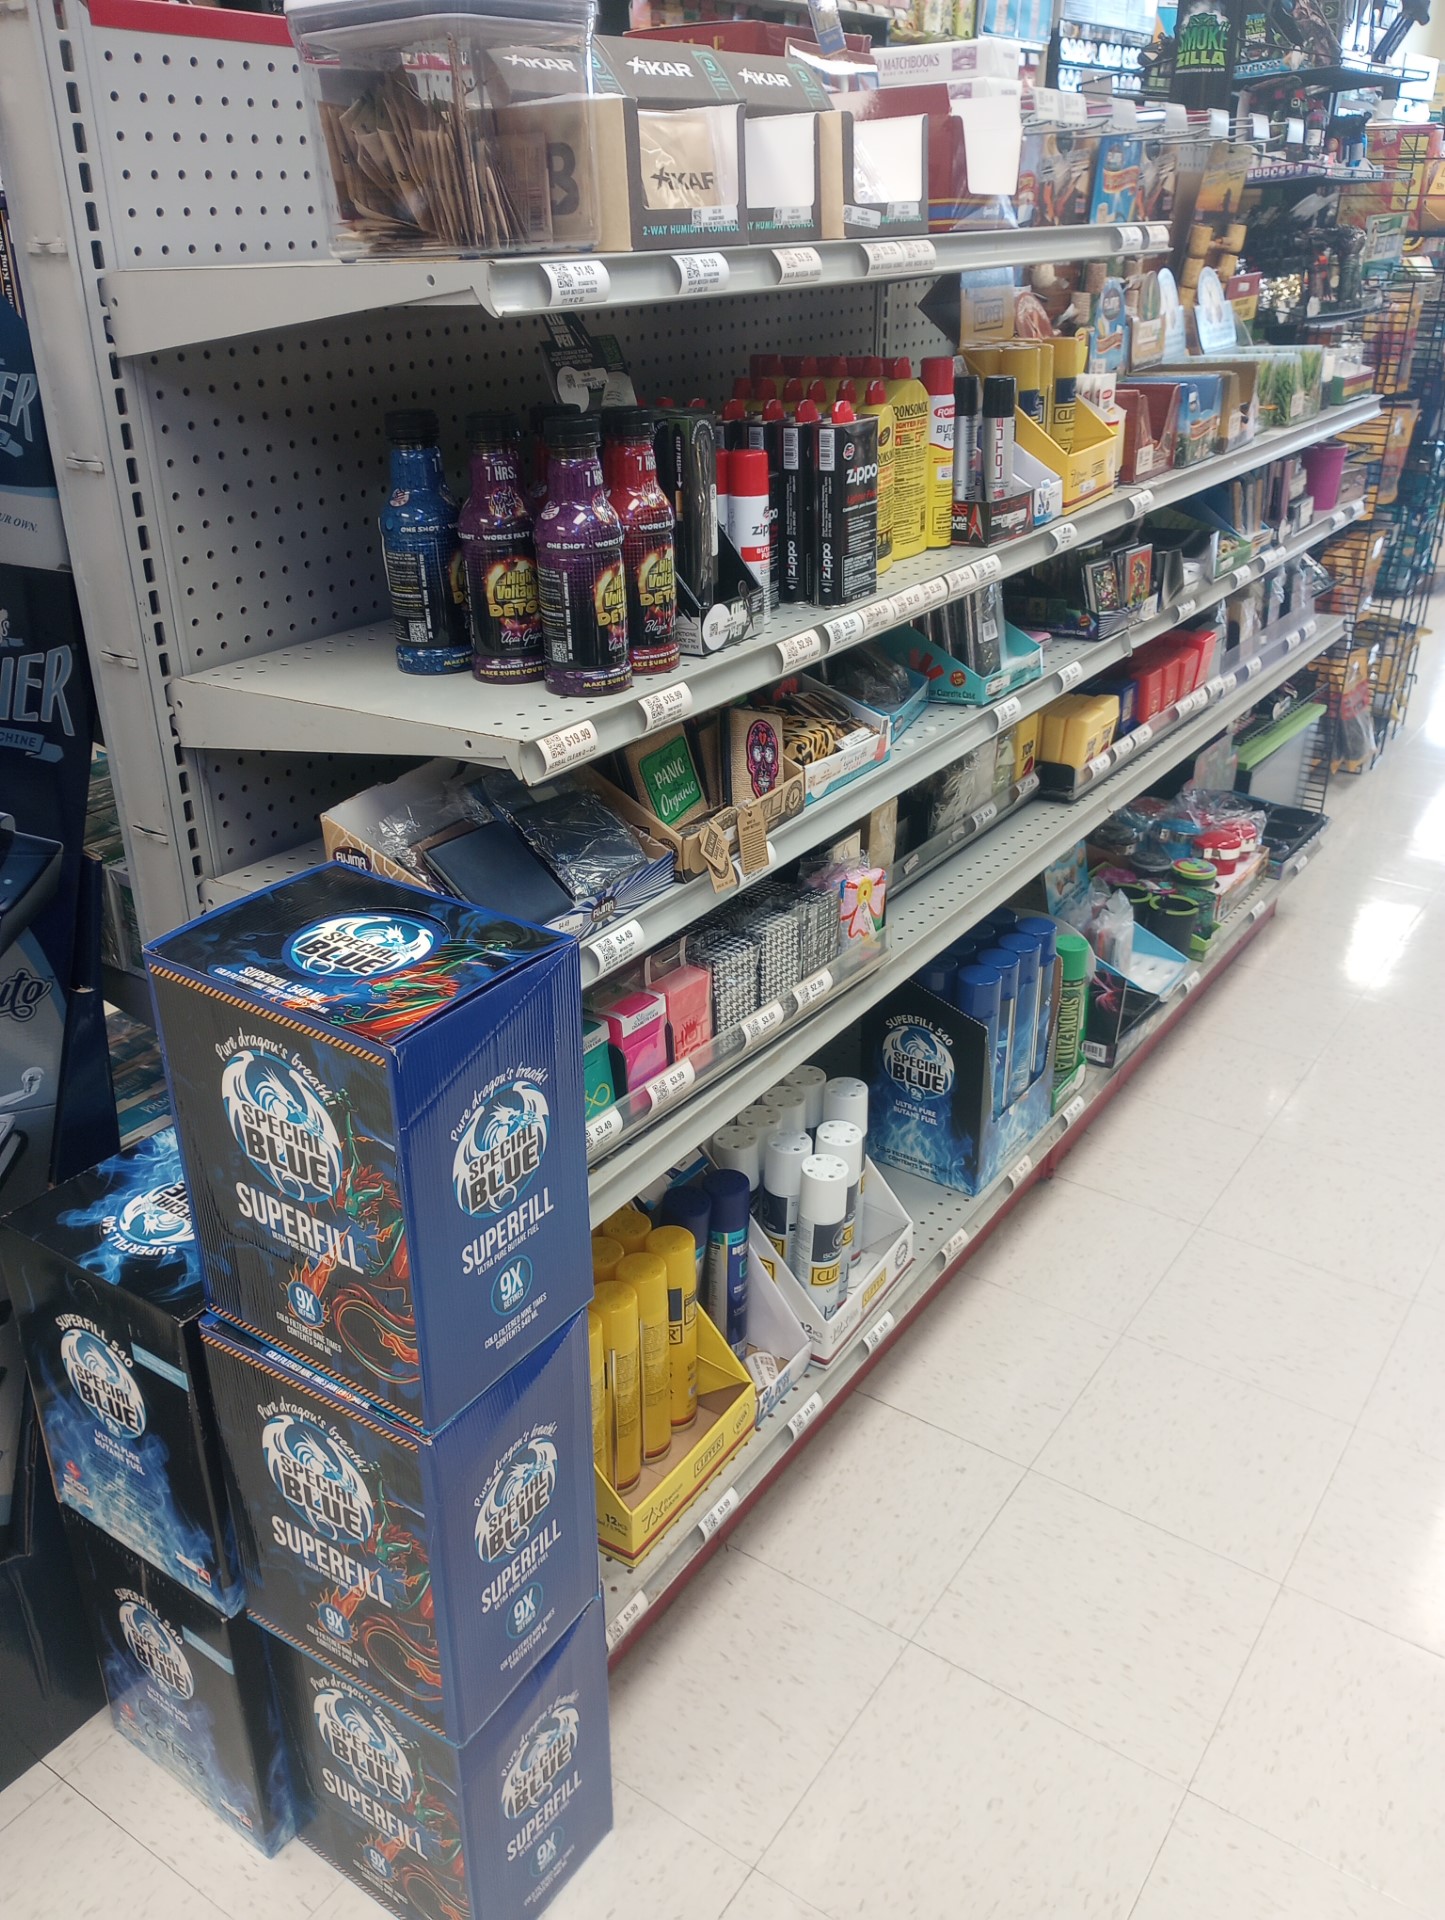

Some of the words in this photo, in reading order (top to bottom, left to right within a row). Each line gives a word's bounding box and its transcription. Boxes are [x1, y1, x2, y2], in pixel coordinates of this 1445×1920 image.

[1178, 26, 1228, 51] SMOKE
[503, 54, 577, 73] XIKAR
[626, 55, 695, 78] XIKAR
[884, 54, 939, 70] MATCHBOOKS
[1176, 50, 1226, 68] ZILLA
[737, 67, 792, 88] XIKAR
[643, 225, 667, 236] 2-WAY
[573, 264, 595, 276] $1.49
[485, 466, 492, 482] 7
[494, 465, 517, 481] HRS.
[585, 471, 591, 487] 7
[637, 456, 642, 471] 7
[846, 463, 878, 486] zippo
[13, 516, 38, 533] OWN.
[483, 533, 513, 541] WORKS
[513, 531, 530, 540] FAST
[639, 522, 667, 531] WORKS
[562, 542, 585, 550] SHOT
[787, 540, 798, 577] zippo
[822, 543, 833, 579] zippo
[488, 602, 539, 618] DETO
[797, 636, 813, 650] $2.99
[583, 681, 606, 689] MAKE
[607, 677, 625, 686] SURE
[662, 690, 684, 705] $15.99
[564, 728, 592, 747] $19.99
[653, 757, 686, 790] PANIC
[660, 780, 698, 817] Organic
[335, 850, 368, 870] FUJIMA
[593, 900, 615, 919] FUJIMA
[324, 930, 395, 962] SPECIAL
[616, 929, 633, 944] $4.49
[301, 939, 387, 977] BLUE
[239, 966, 292, 990] SUPERFILL
[287, 984, 313, 997] 540
[885, 1014, 934, 1031] SUPERFILL
[935, 1027, 954, 1047] 540
[215, 1034, 237, 1062] Pure
[238, 1027, 288, 1058] dragon's
[290, 1053, 336, 1106] breath!
[669, 1071, 685, 1086] $3.99
[892, 1063, 945, 1094] BLUE
[893, 1051, 944, 1077] SPECIAL
[450, 1109, 471, 1143] Pure
[471, 1066, 514, 1106] dragon's
[515, 1061, 548, 1086] breath!
[893, 1105, 920, 1120] BUTANE
[921, 1113, 938, 1126] FUEL
[895, 1099, 918, 1112] ULTRA
[919, 1106, 936, 1118] PURE
[241, 1103, 328, 1160] SPECIAL
[595, 1120, 612, 1136] $3.49
[244, 1123, 333, 1197] BLUE
[469, 1126, 537, 1182] SPECIAL
[469, 1142, 540, 1215] BLUE
[102, 1215, 118, 1235] 540
[235, 1181, 364, 1275] SUPERFILL
[461, 1187, 555, 1276] SUPERFILL
[107, 1232, 177, 1256] SUPERFILL
[477, 1259, 494, 1277] ULTRA
[494, 1249, 508, 1267] PURE
[508, 1234, 528, 1257] BUTANE
[527, 1223, 540, 1243] FUEL
[500, 1261, 524, 1301] 9X
[295, 1287, 315, 1315] 9X
[503, 1288, 524, 1310] REFINED
[276, 1312, 289, 1321] COLD
[290, 1319, 312, 1336] FILTERED
[312, 1329, 325, 1344] NINE
[326, 1338, 342, 1353] TIMES
[485, 1332, 498, 1350] COLD
[498, 1310, 521, 1338] FILTERED
[520, 1301, 533, 1320] NINE
[532, 1291, 548, 1312] TIMES
[495, 1322, 521, 1351] CONTENTS
[521, 1315, 531, 1332] 540
[531, 1310, 539, 1324] ML
[55, 1313, 108, 1345] SUPERFILL
[110, 1340, 134, 1369] 540
[287, 1325, 314, 1346] CONTENTS
[314, 1340, 324, 1351] 540
[324, 1346, 332, 1357] ML
[75, 1362, 135, 1409] SPECIAL
[77, 1378, 139, 1434] BLUE
[95, 1429, 120, 1448] ULTRA
[120, 1445, 141, 1464] PURE
[256, 1400, 279, 1421] Pure
[279, 1395, 327, 1432] dragon's
[327, 1423, 370, 1475] breath!
[95, 1437, 125, 1463] BUTANE
[125, 1456, 146, 1476] FUEL
[474, 1475, 493, 1508] Pure
[493, 1432, 530, 1475] dragon's
[530, 1420, 558, 1440] breath!
[280, 1454, 360, 1512] SPECIAL
[283, 1473, 365, 1543] BLUE
[489, 1471, 547, 1536] SPECIAL
[605, 1513, 618, 1526] 12
[488, 1483, 549, 1562] BLUE
[271, 1515, 392, 1609] SUPERFILL
[481, 1518, 562, 1614] SUPERFILL
[114, 1587, 161, 1620] SUPERFILL
[163, 1618, 184, 1645] 540
[324, 1606, 345, 1636] 9X
[513, 1588, 535, 1625] 9X
[132, 1630, 182, 1680] SPECIAL
[136, 1647, 188, 1698] BLUE
[310, 1676, 330, 1692] Pure
[330, 1720, 401, 1776] SPECIAL
[514, 1734, 569, 1795] SPECIAL
[331, 1735, 405, 1804] BLUE
[513, 1748, 572, 1818] BLUE
[322, 1767, 428, 1861] SUPERFILL
[507, 1770, 583, 1862] SUPERFILL
[369, 1848, 387, 1873] 9X
[536, 1832, 557, 1867] 9X
